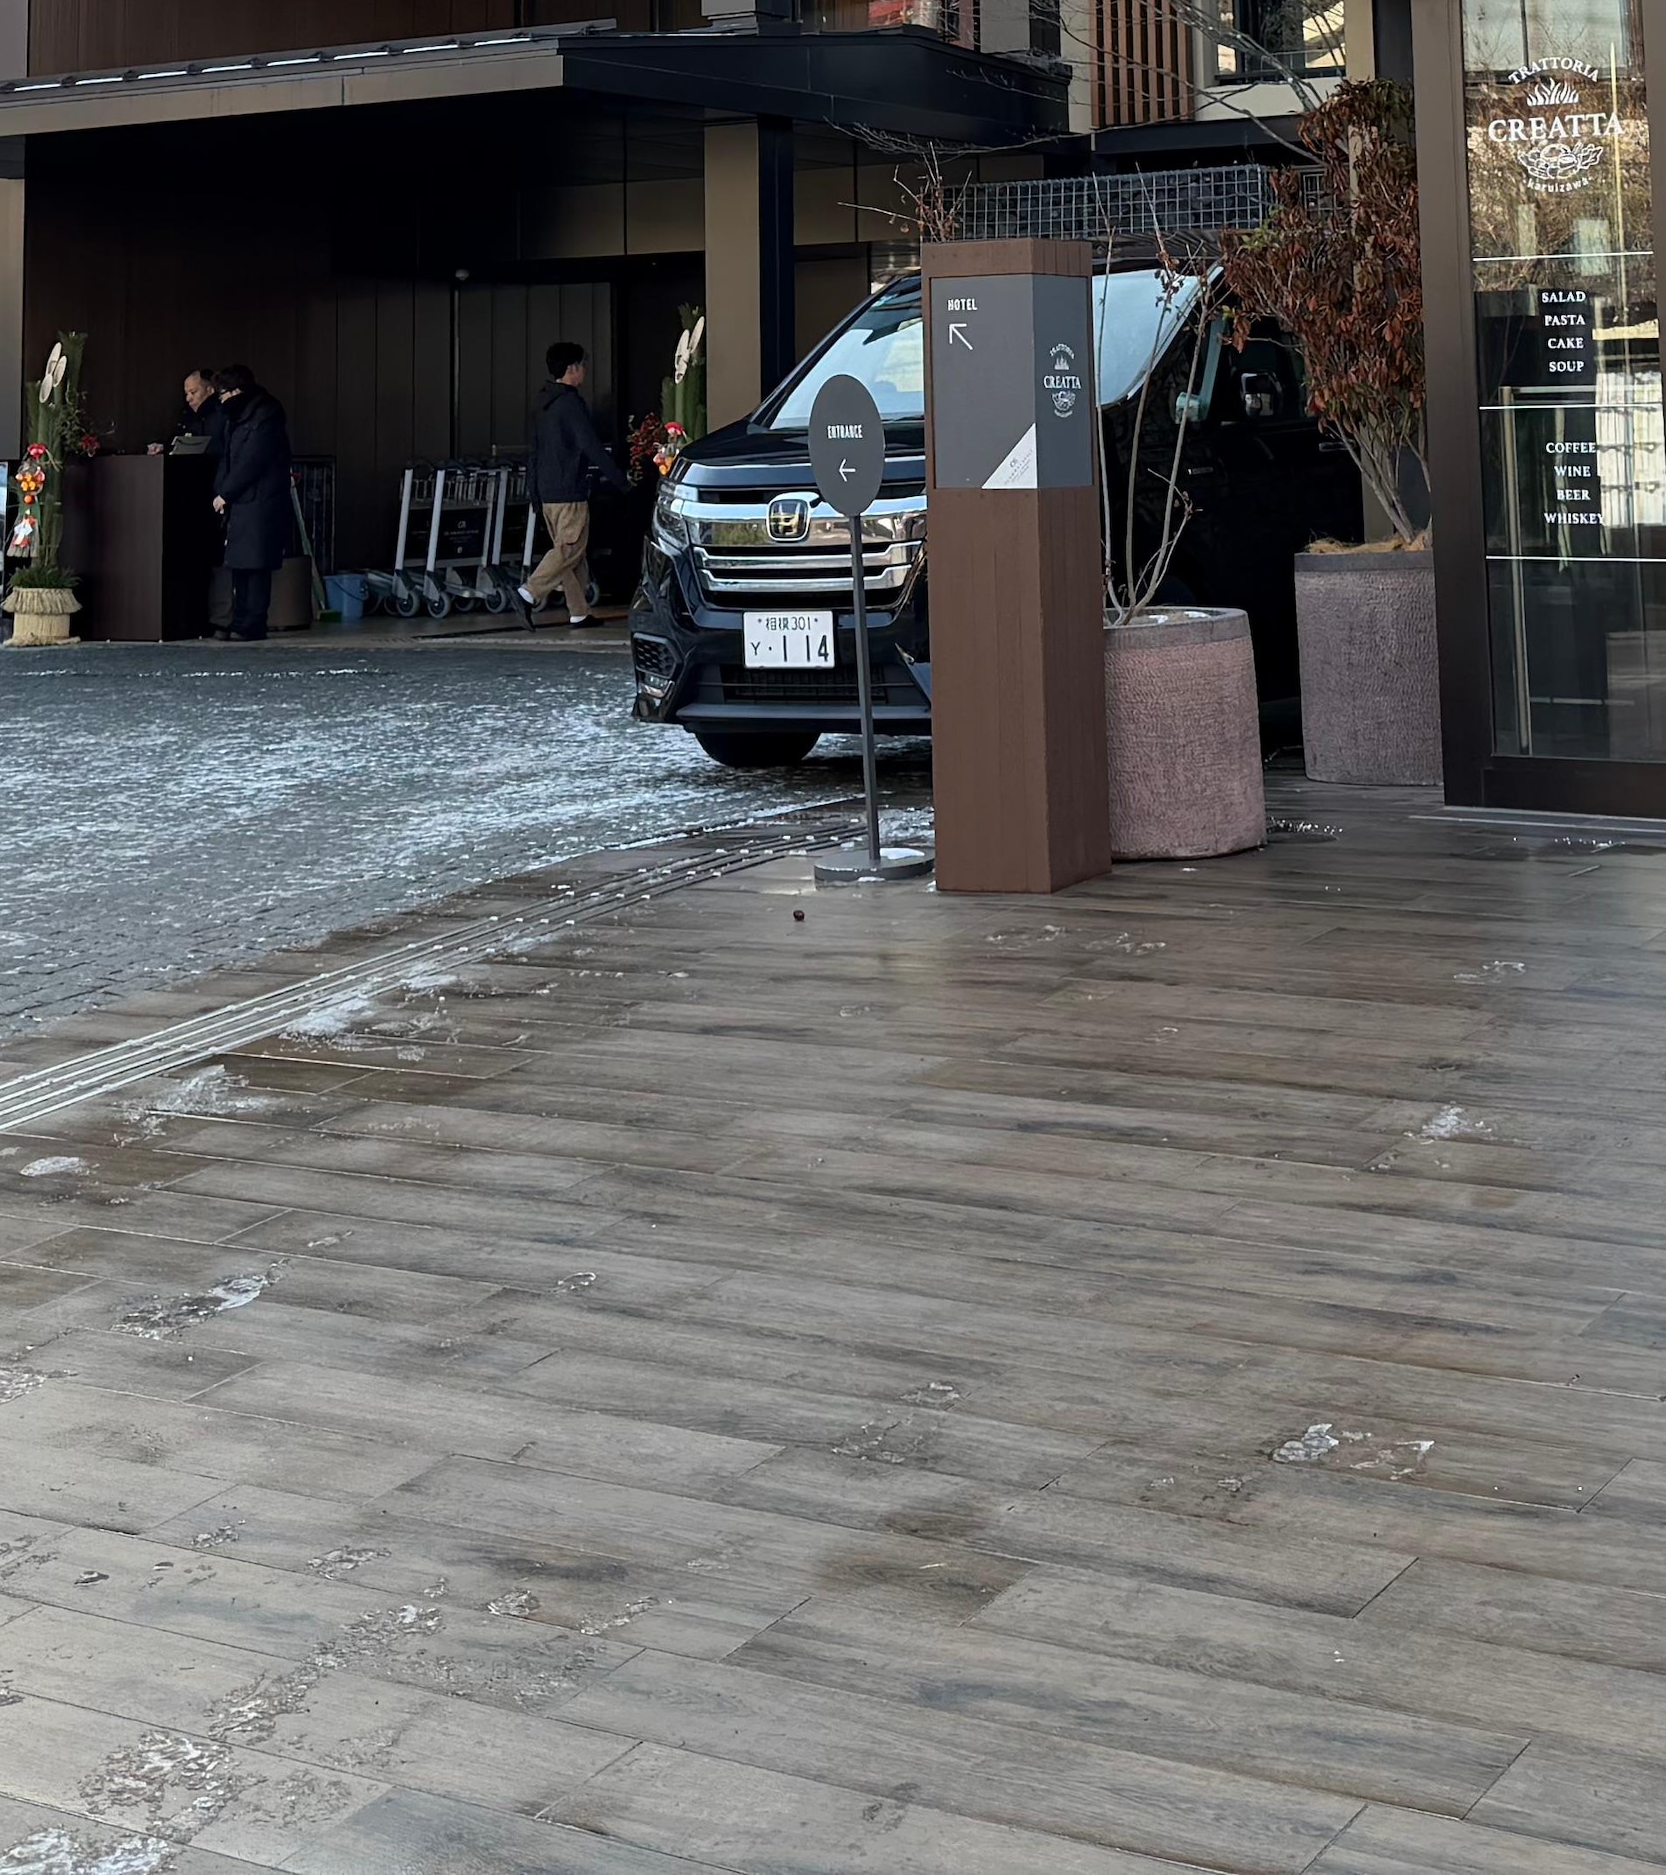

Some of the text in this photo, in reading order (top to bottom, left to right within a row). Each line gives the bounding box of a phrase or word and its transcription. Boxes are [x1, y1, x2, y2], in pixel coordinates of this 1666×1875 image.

[1508, 57, 1599, 85] TRATTORIA
[1488, 112, 1625, 142] CREATTA
[1541, 290, 1586, 303] SALAD
[947, 298, 978, 311] HOTEL
[1544, 314, 1586, 327] PASTA
[1547, 337, 1584, 349] CAKE
[1548, 360, 1584, 372] SOUP
[1043, 375, 1081, 389] CREATTA
[827, 424, 863, 439] ENTRANCE
[1545, 442, 1596, 454] COFFEE
[1554, 465, 1591, 478] WINE
[1556, 489, 1591, 501] BEER
[1543, 512, 1606, 525] WHISKEY
